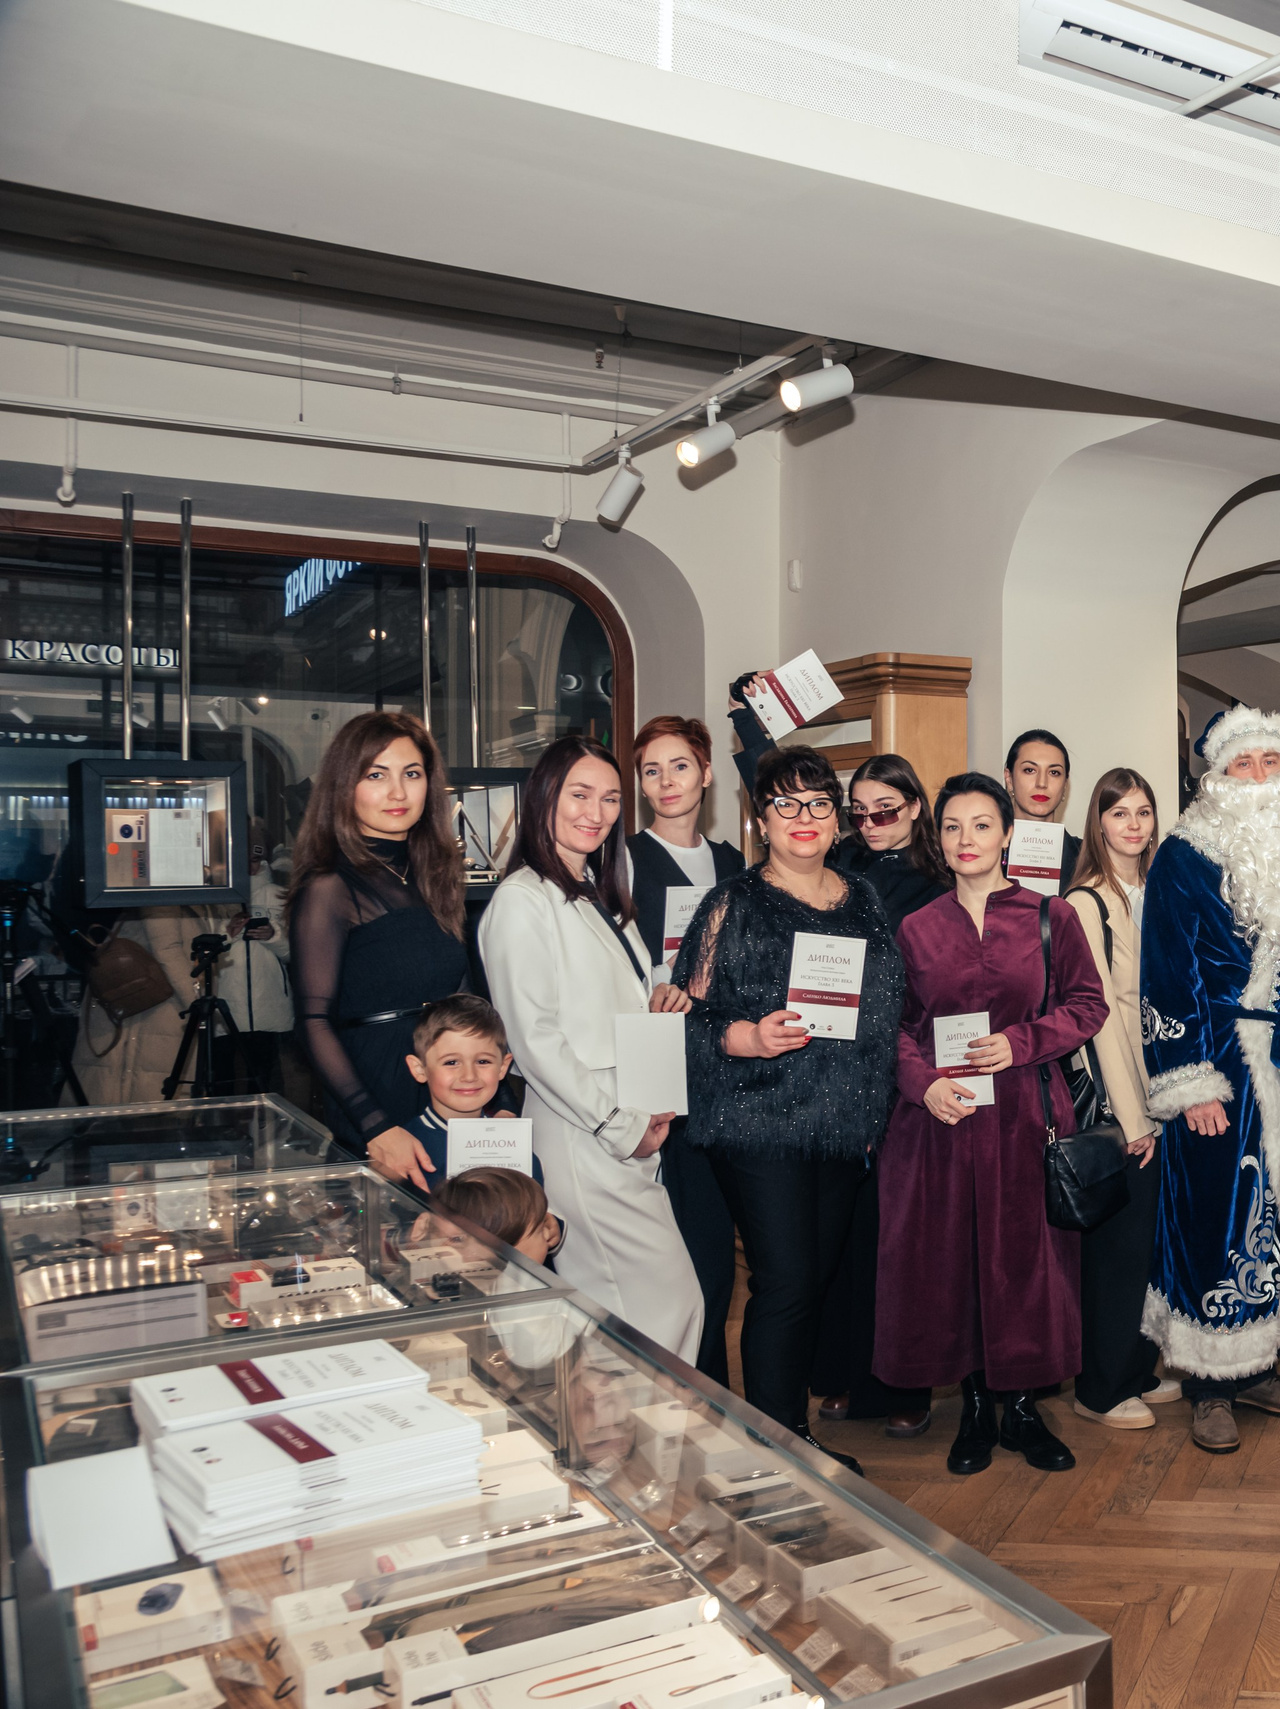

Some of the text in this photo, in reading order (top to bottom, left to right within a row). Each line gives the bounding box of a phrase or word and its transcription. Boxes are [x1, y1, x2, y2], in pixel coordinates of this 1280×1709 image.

[8, 638, 180, 668] КРАСОТЫ
[1021, 836, 1054, 845] ДИПЛОМ
[807, 953, 851, 965] ДИПЛОМ
[945, 1031, 980, 1042] ДИПЛОМ
[465, 1139, 517, 1149] ДИПЛОМ
